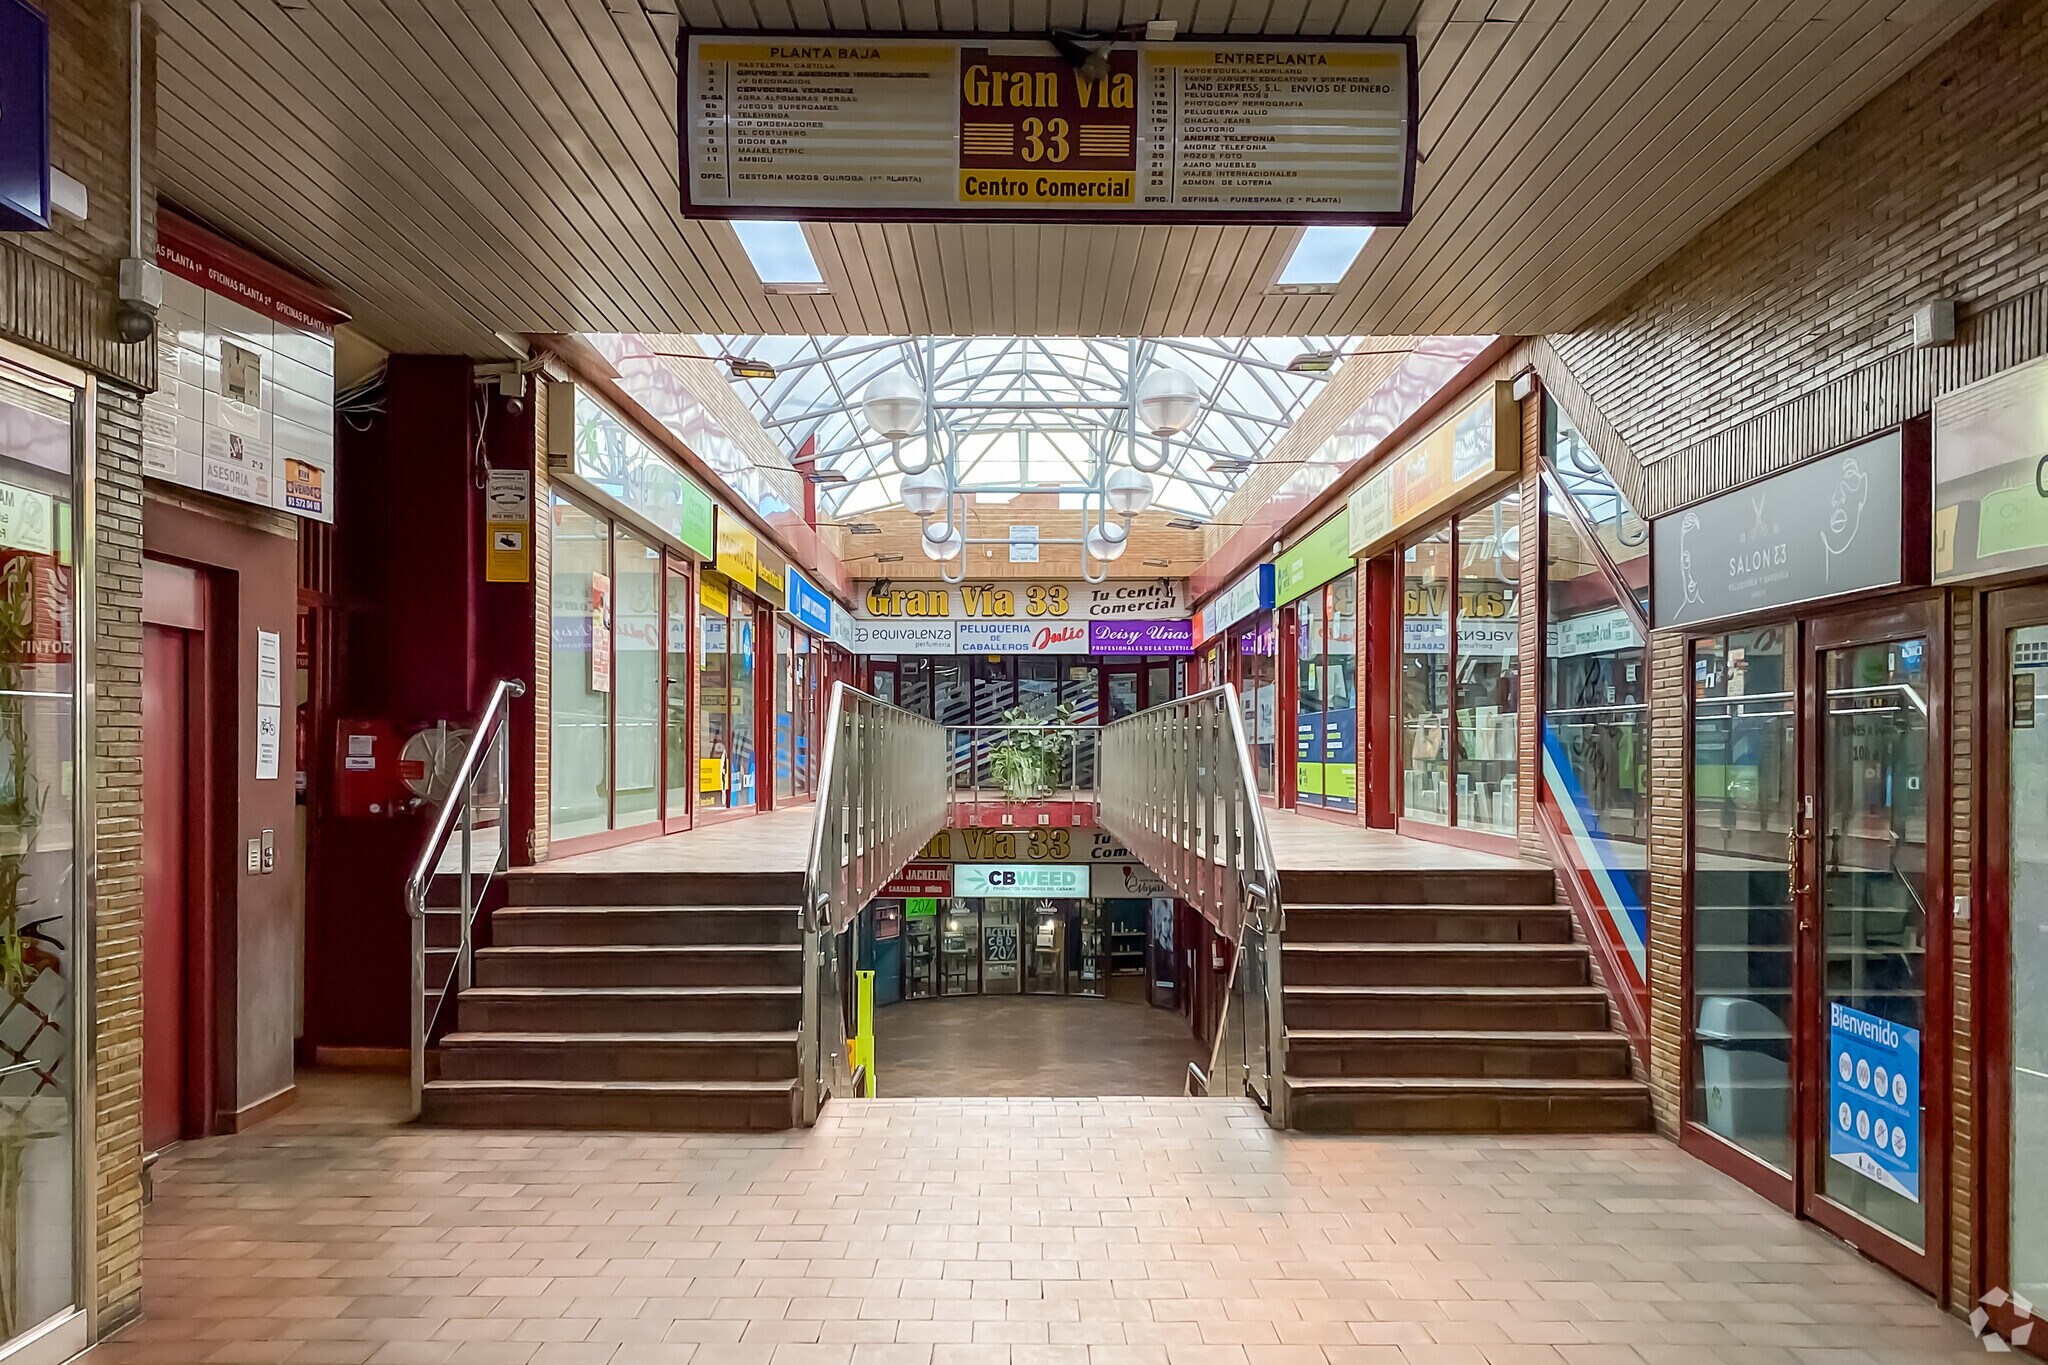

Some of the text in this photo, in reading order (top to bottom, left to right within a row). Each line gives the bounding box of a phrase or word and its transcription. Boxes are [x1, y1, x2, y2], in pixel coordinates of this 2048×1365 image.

[770, 47, 880, 59] PLANTA BAJA
[1215, 52, 1327, 66] ENTREPLANTA
[963, 64, 1058, 107] Gran
[1185, 83, 1213, 91] LAND
[1291, 84, 1330, 93] ENVIOS
[1333, 85, 1346, 93] DE
[1021, 117, 1070, 163] 33
[965, 176, 1130, 197] Centro Comercial
[166, 248, 194, 271] PLANTA
[208, 268, 238, 292] OFICINAS
[239, 282, 265, 305] PLANTA
[276, 300, 302, 321] OFICINAS
[303, 313, 325, 333] PLANTA
[294, 486, 315, 499] VENDE
[1729, 547, 1771, 576] SALON
[866, 585, 949, 617] Gran
[960, 584, 1015, 617] Vía
[1025, 584, 1069, 617] 33
[1091, 590, 1110, 602] Tu
[1089, 597, 1176, 616] Comercial
[960, 624, 1031, 634] PELUQUERIA
[1032, 626, 1084, 650] Julio
[1095, 625, 1142, 645] Deisy
[1146, 625, 1192, 640] Uñas
[915, 641, 950, 649] perfumeria
[962, 643, 1029, 651] CABALLEROS
[961, 828, 1016, 860] Vía
[1028, 828, 1071, 860] 33
[1093, 833, 1112, 845] Tu
[988, 870, 1076, 886] CBWEED
[1831, 1002, 1899, 1049] Bienvenido
